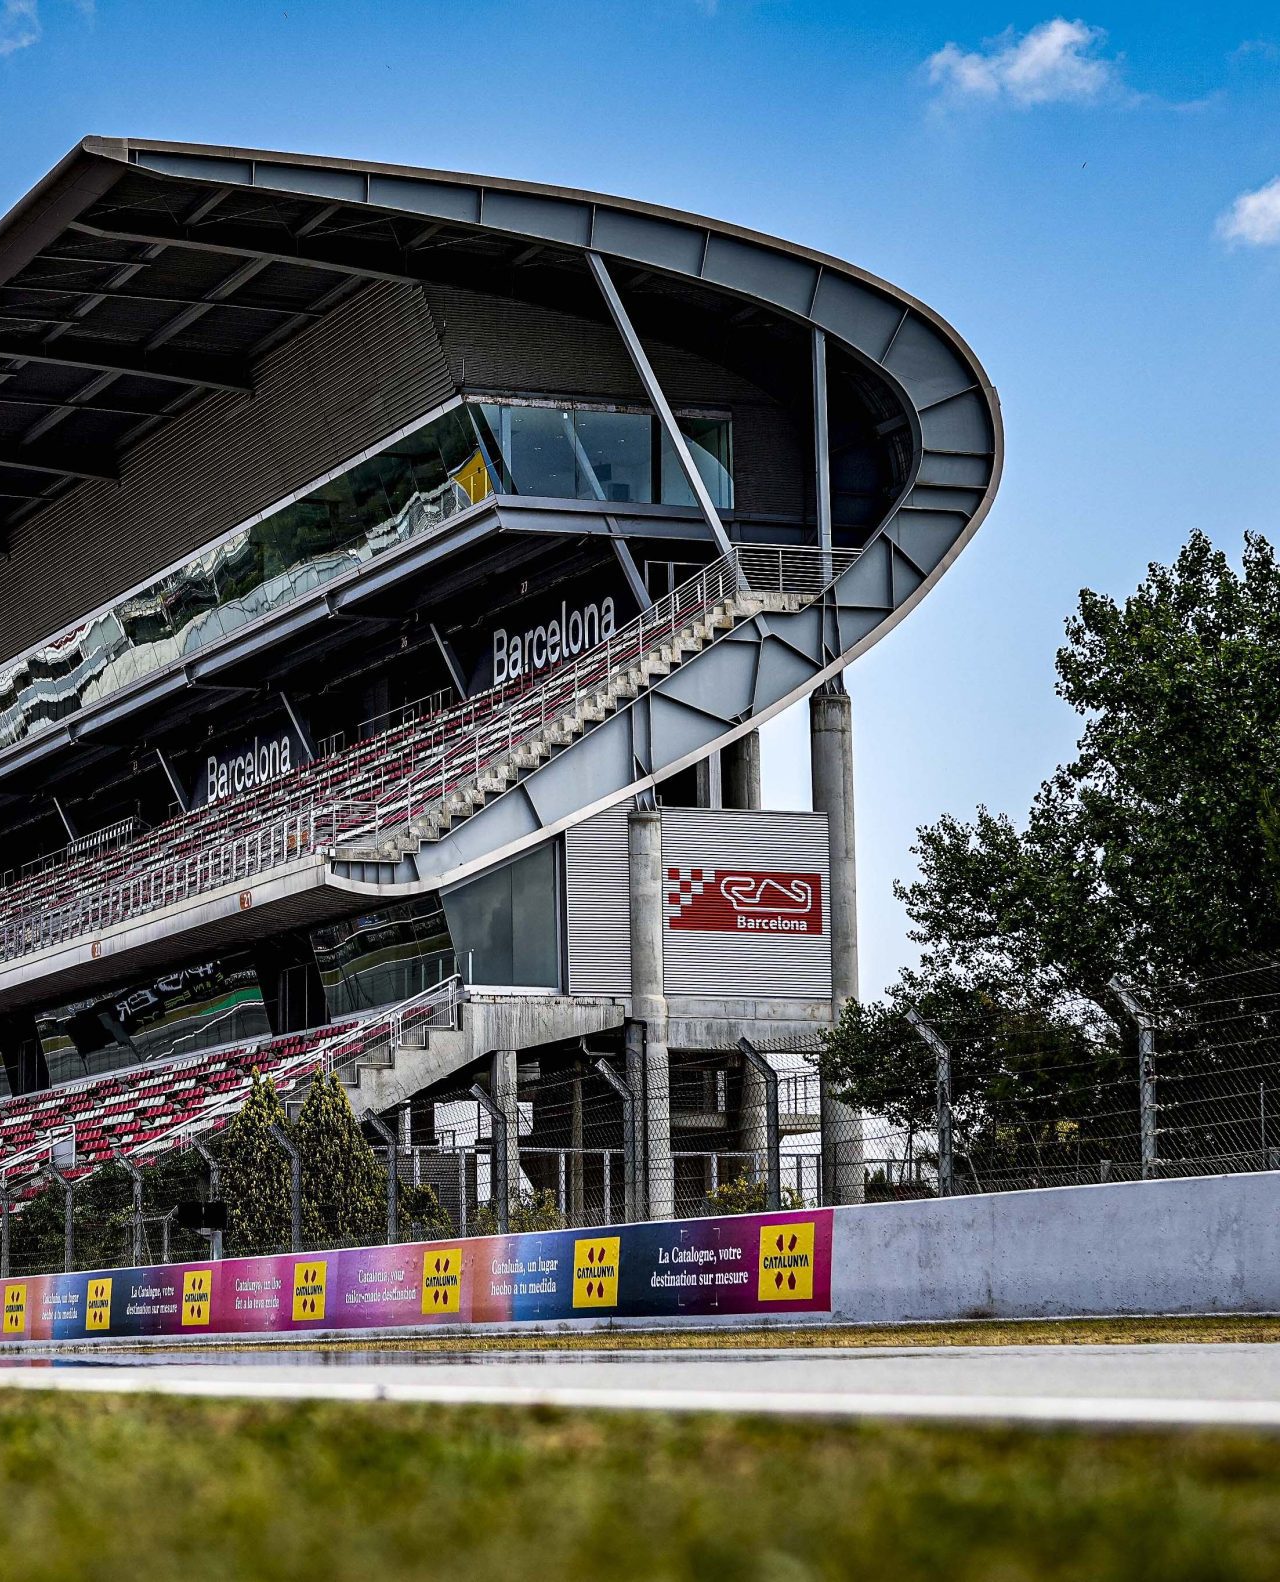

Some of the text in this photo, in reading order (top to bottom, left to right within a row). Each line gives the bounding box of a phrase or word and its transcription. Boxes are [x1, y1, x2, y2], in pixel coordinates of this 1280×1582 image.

[493, 597, 616, 687] Barcelona
[207, 736, 290, 804] Barcelona
[737, 915, 808, 931] Barcelona
[658, 1246, 742, 1266] La Catalogne, votre
[763, 1254, 809, 1269] CATALUNYA
[491, 1256, 559, 1276] Cataluña, un lugar
[577, 1265, 615, 1279] CATALUNYA
[425, 1274, 458, 1288] CATALUNYA
[491, 1277, 557, 1296] hecho a tu medida
[650, 1270, 749, 1287] destination sur mesure
[295, 1285, 323, 1296] CATALUNYA
